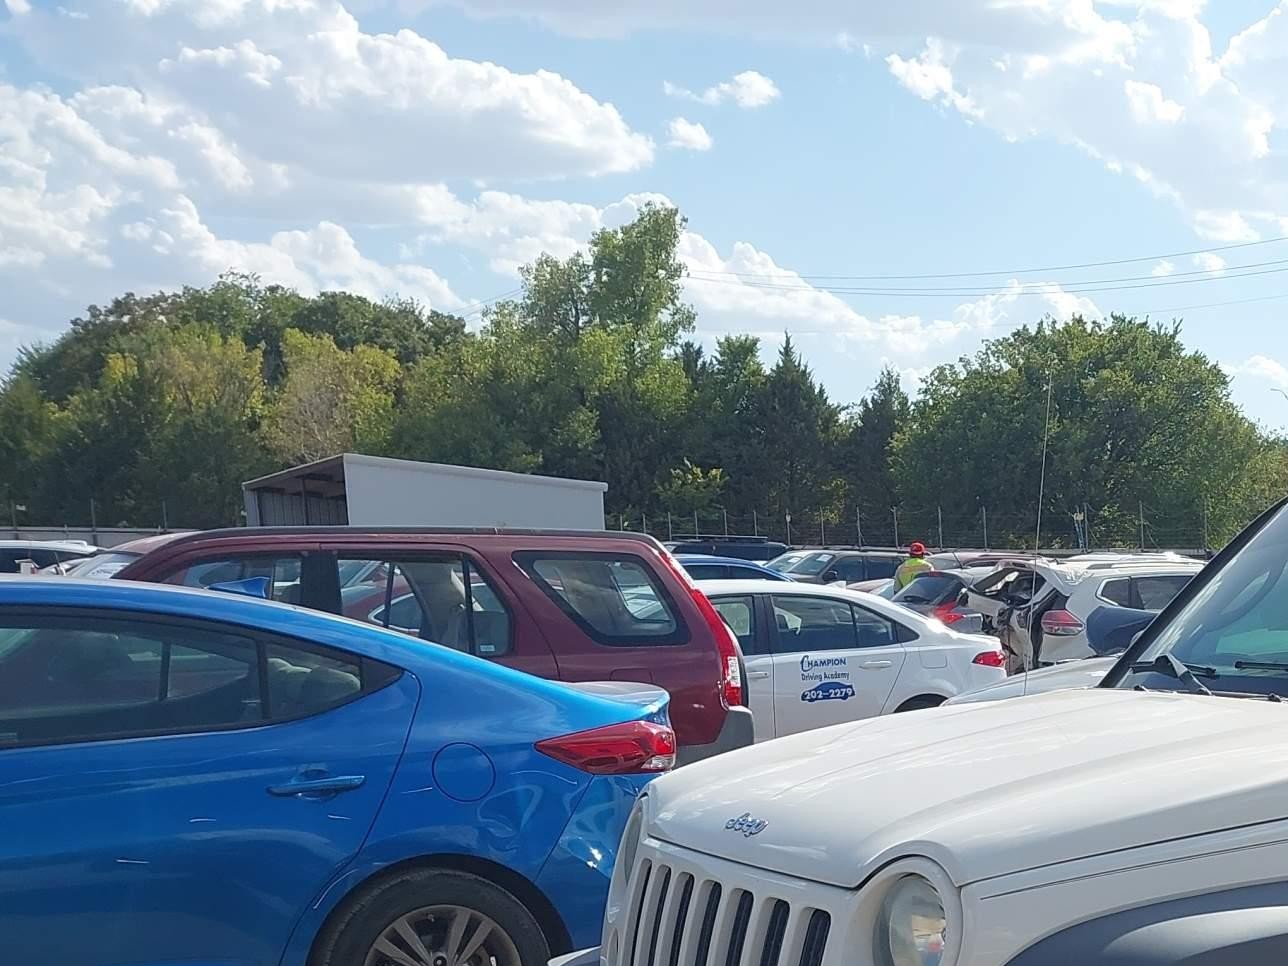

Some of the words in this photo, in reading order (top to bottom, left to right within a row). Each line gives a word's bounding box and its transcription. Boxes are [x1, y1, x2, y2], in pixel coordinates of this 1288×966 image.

[801, 672, 823, 682] Driving
[823, 671, 850, 681] Academy
[804, 688, 853, 700] 202-2279
